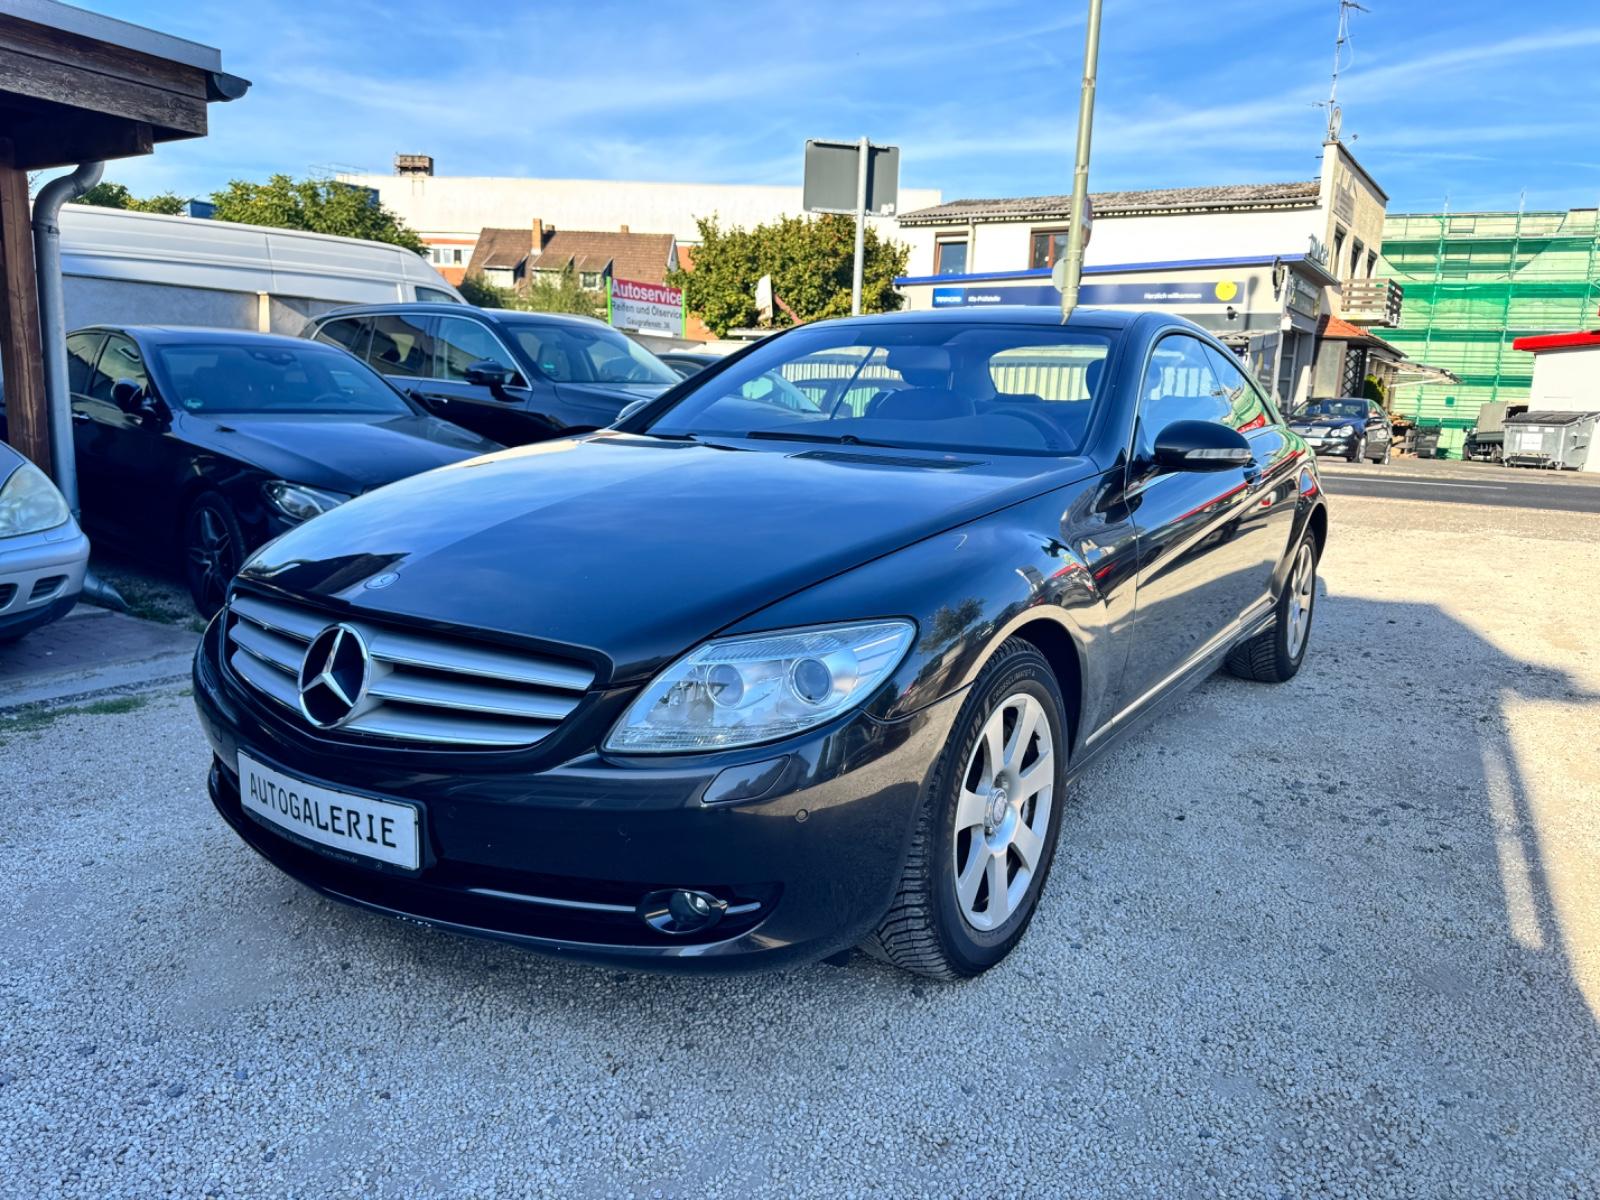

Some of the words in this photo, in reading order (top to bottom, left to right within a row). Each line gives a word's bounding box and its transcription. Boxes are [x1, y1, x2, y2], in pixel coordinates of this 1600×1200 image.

[612, 279, 682, 305] Autoservice
[636, 306, 650, 315] und
[949, 711, 982, 823] MICHELIN
[250, 772, 397, 848] AUTOGALERIE
